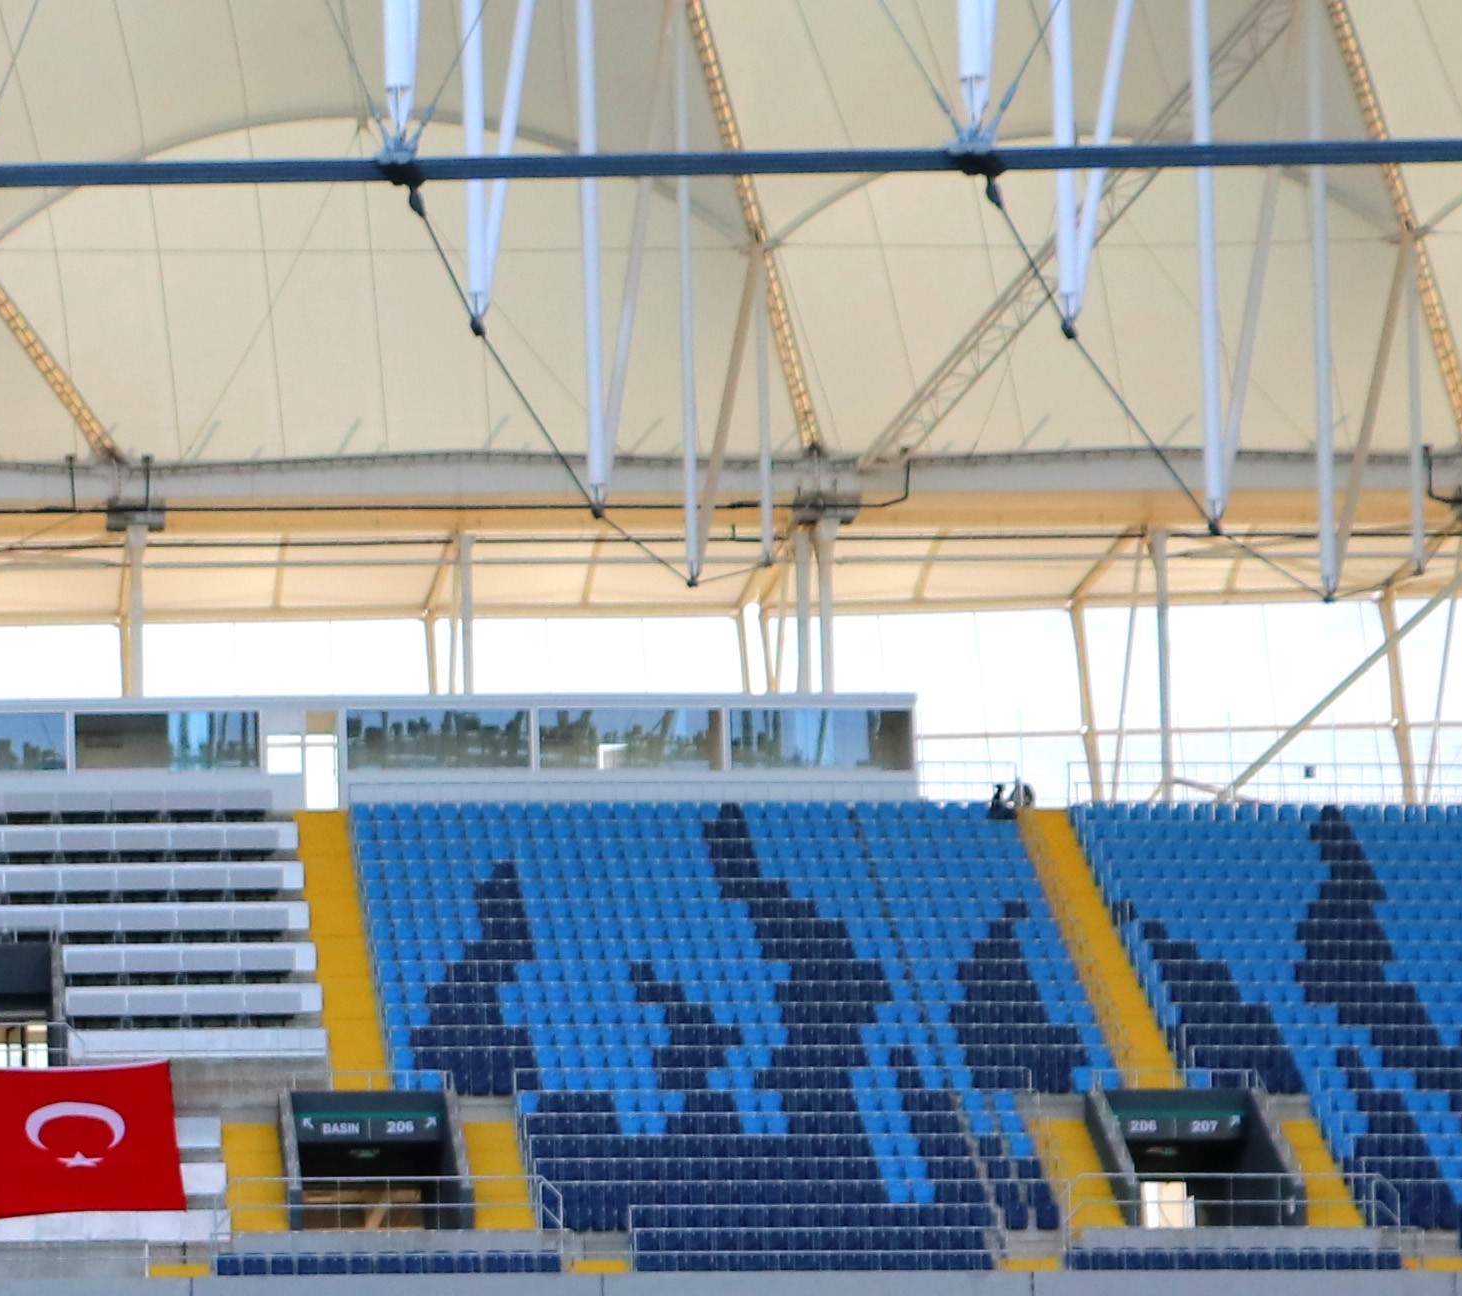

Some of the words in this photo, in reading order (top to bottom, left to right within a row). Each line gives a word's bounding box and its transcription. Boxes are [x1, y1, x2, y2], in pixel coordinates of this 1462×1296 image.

[323, 1121, 360, 1134] BASIN
[386, 1120, 415, 1133] 206
[1130, 1119, 1157, 1133] 206
[1192, 1120, 1218, 1134] 207
